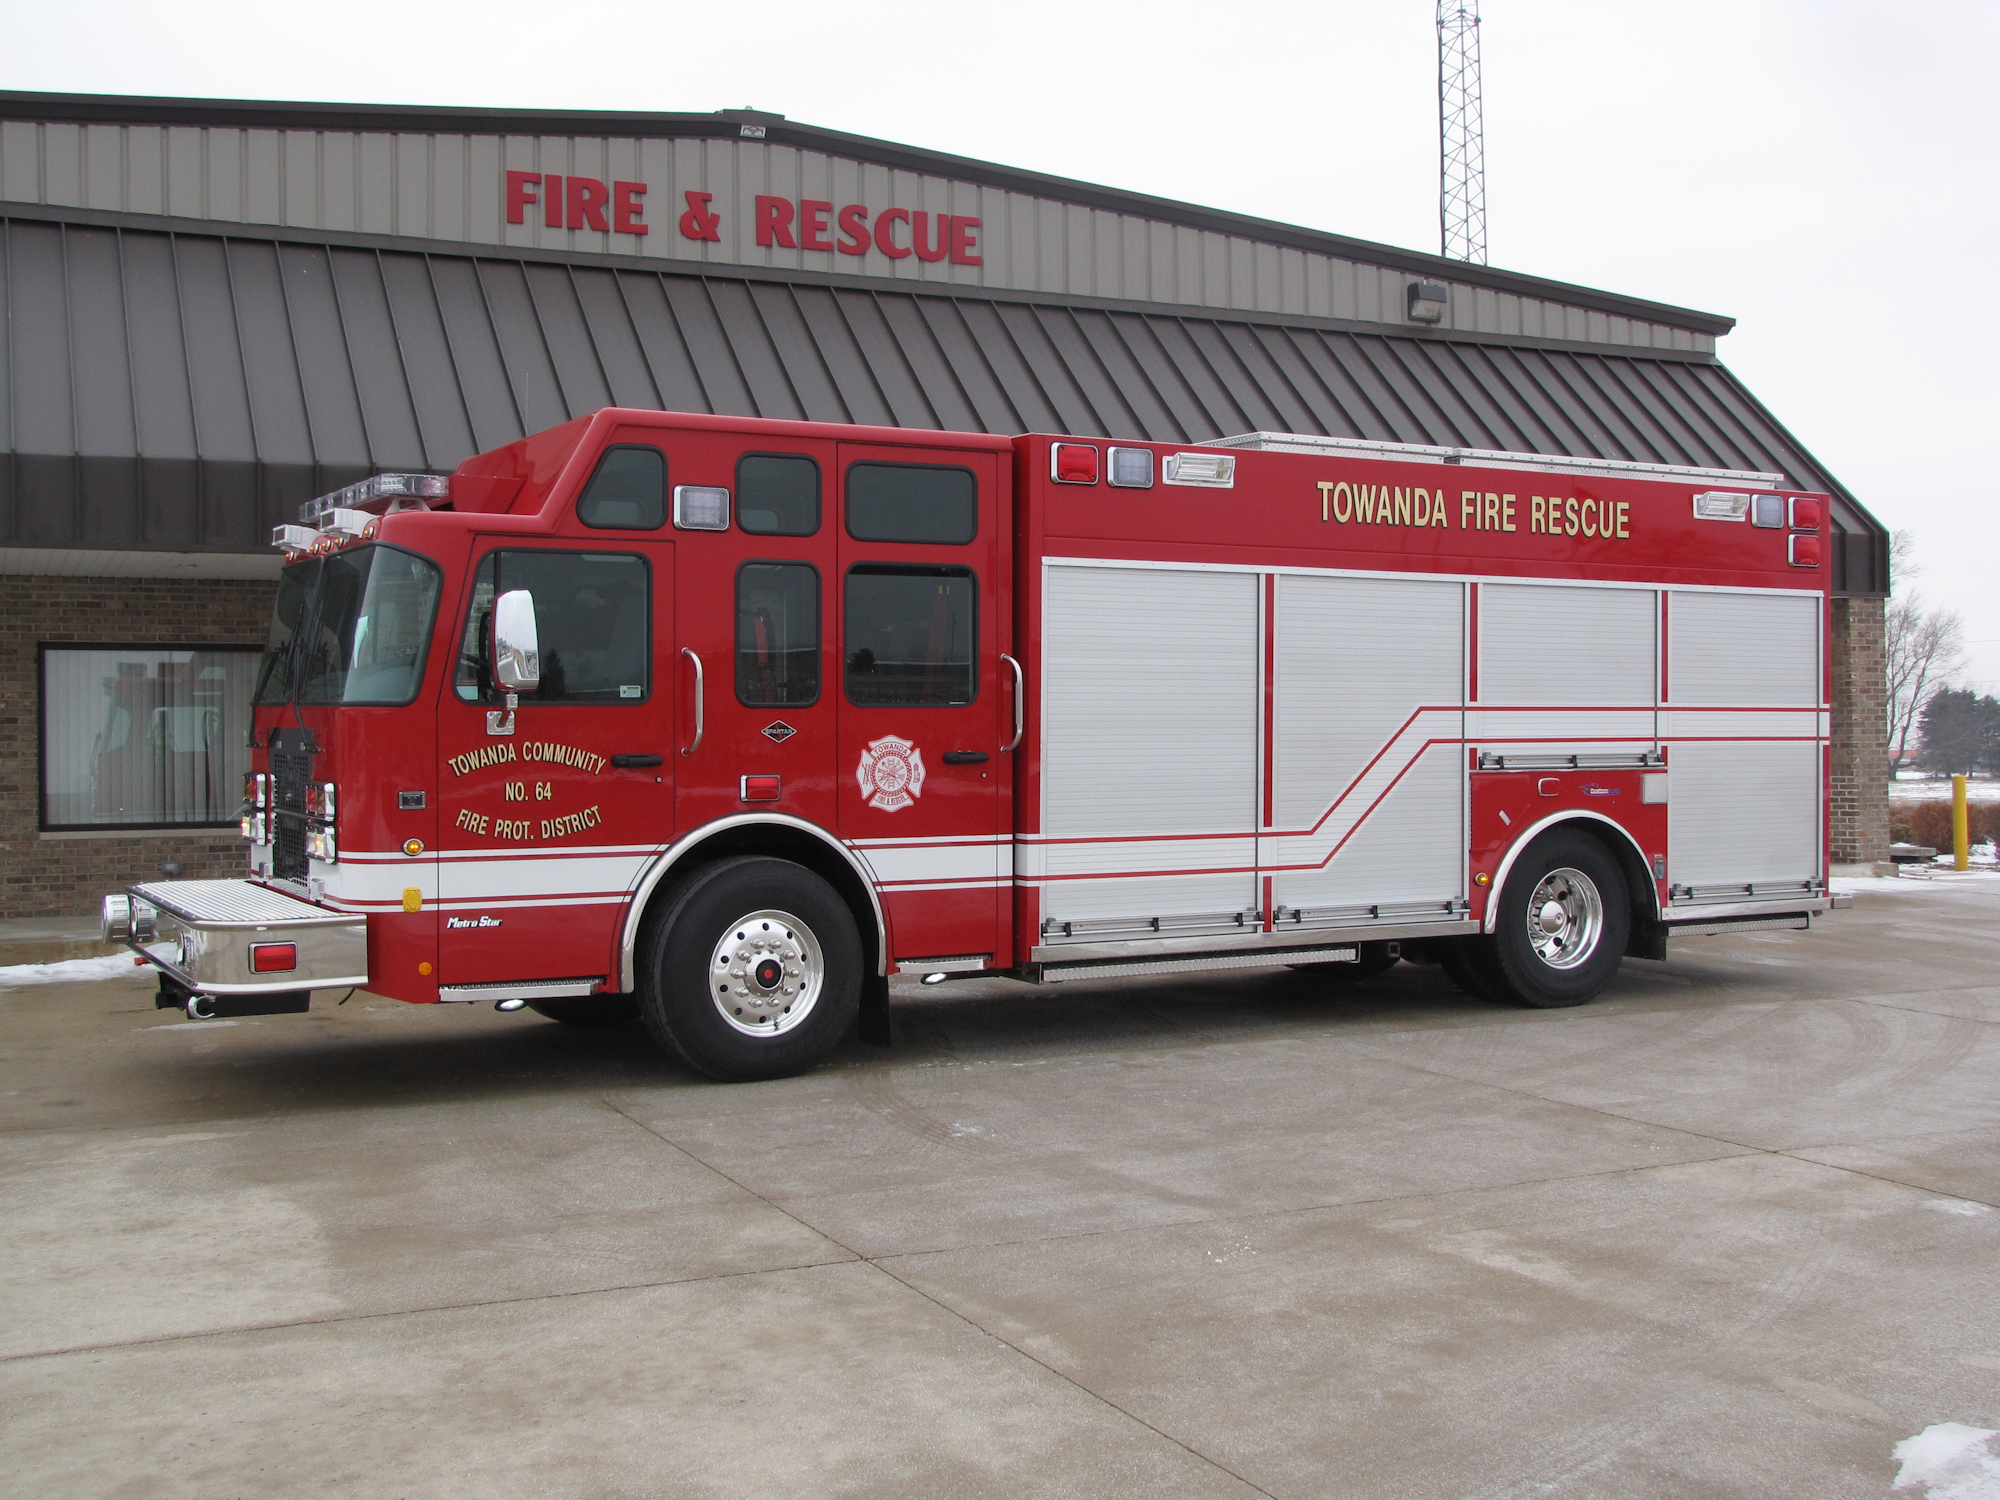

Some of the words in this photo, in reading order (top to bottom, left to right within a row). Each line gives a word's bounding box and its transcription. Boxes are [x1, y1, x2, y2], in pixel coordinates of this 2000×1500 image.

[505, 169, 649, 236] FIRE
[679, 190, 722, 243] &
[755, 194, 983, 267] RESCUE
[1316, 480, 1448, 529] TOWANDA
[1461, 491, 1517, 532] FIRE
[1531, 495, 1630, 539] RESCUE
[448, 742, 517, 777] TOWANDA
[522, 741, 607, 775] COMMUNITY
[874, 743, 908, 755] TOWANDA
[505, 782, 529, 802] NO.
[535, 781, 552, 801] 64
[455, 808, 489, 836] FIRE
[494, 818, 534, 840] PROT.
[541, 805, 602, 840] DISTRICT
[447, 917, 478, 929] Metro
[479, 915, 503, 928] Star
